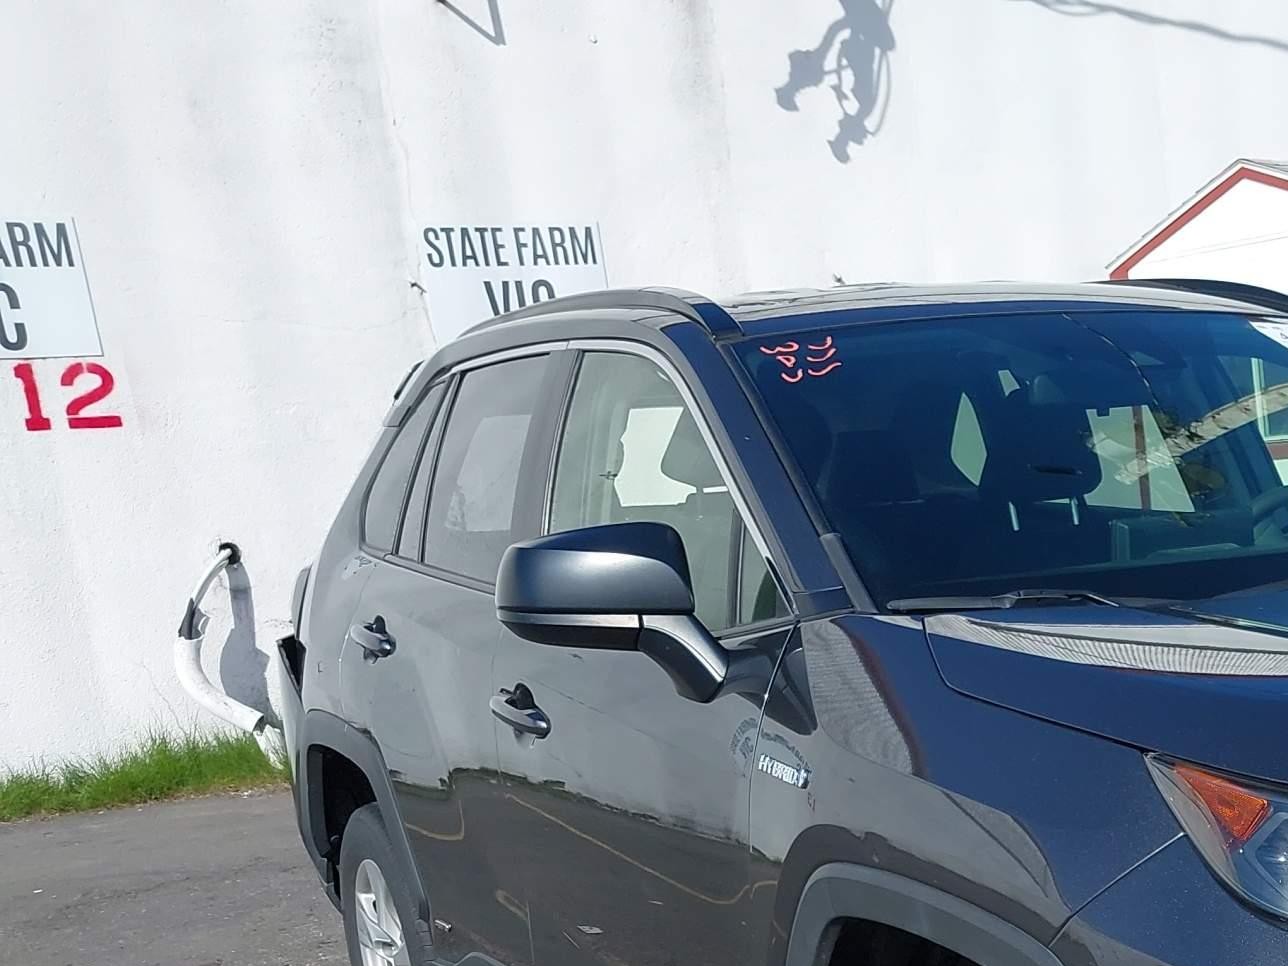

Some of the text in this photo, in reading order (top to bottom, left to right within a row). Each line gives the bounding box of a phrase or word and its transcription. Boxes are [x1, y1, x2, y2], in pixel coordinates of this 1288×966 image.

[423, 226, 598, 268] STATE FARM
[13, 362, 123, 431] 12
